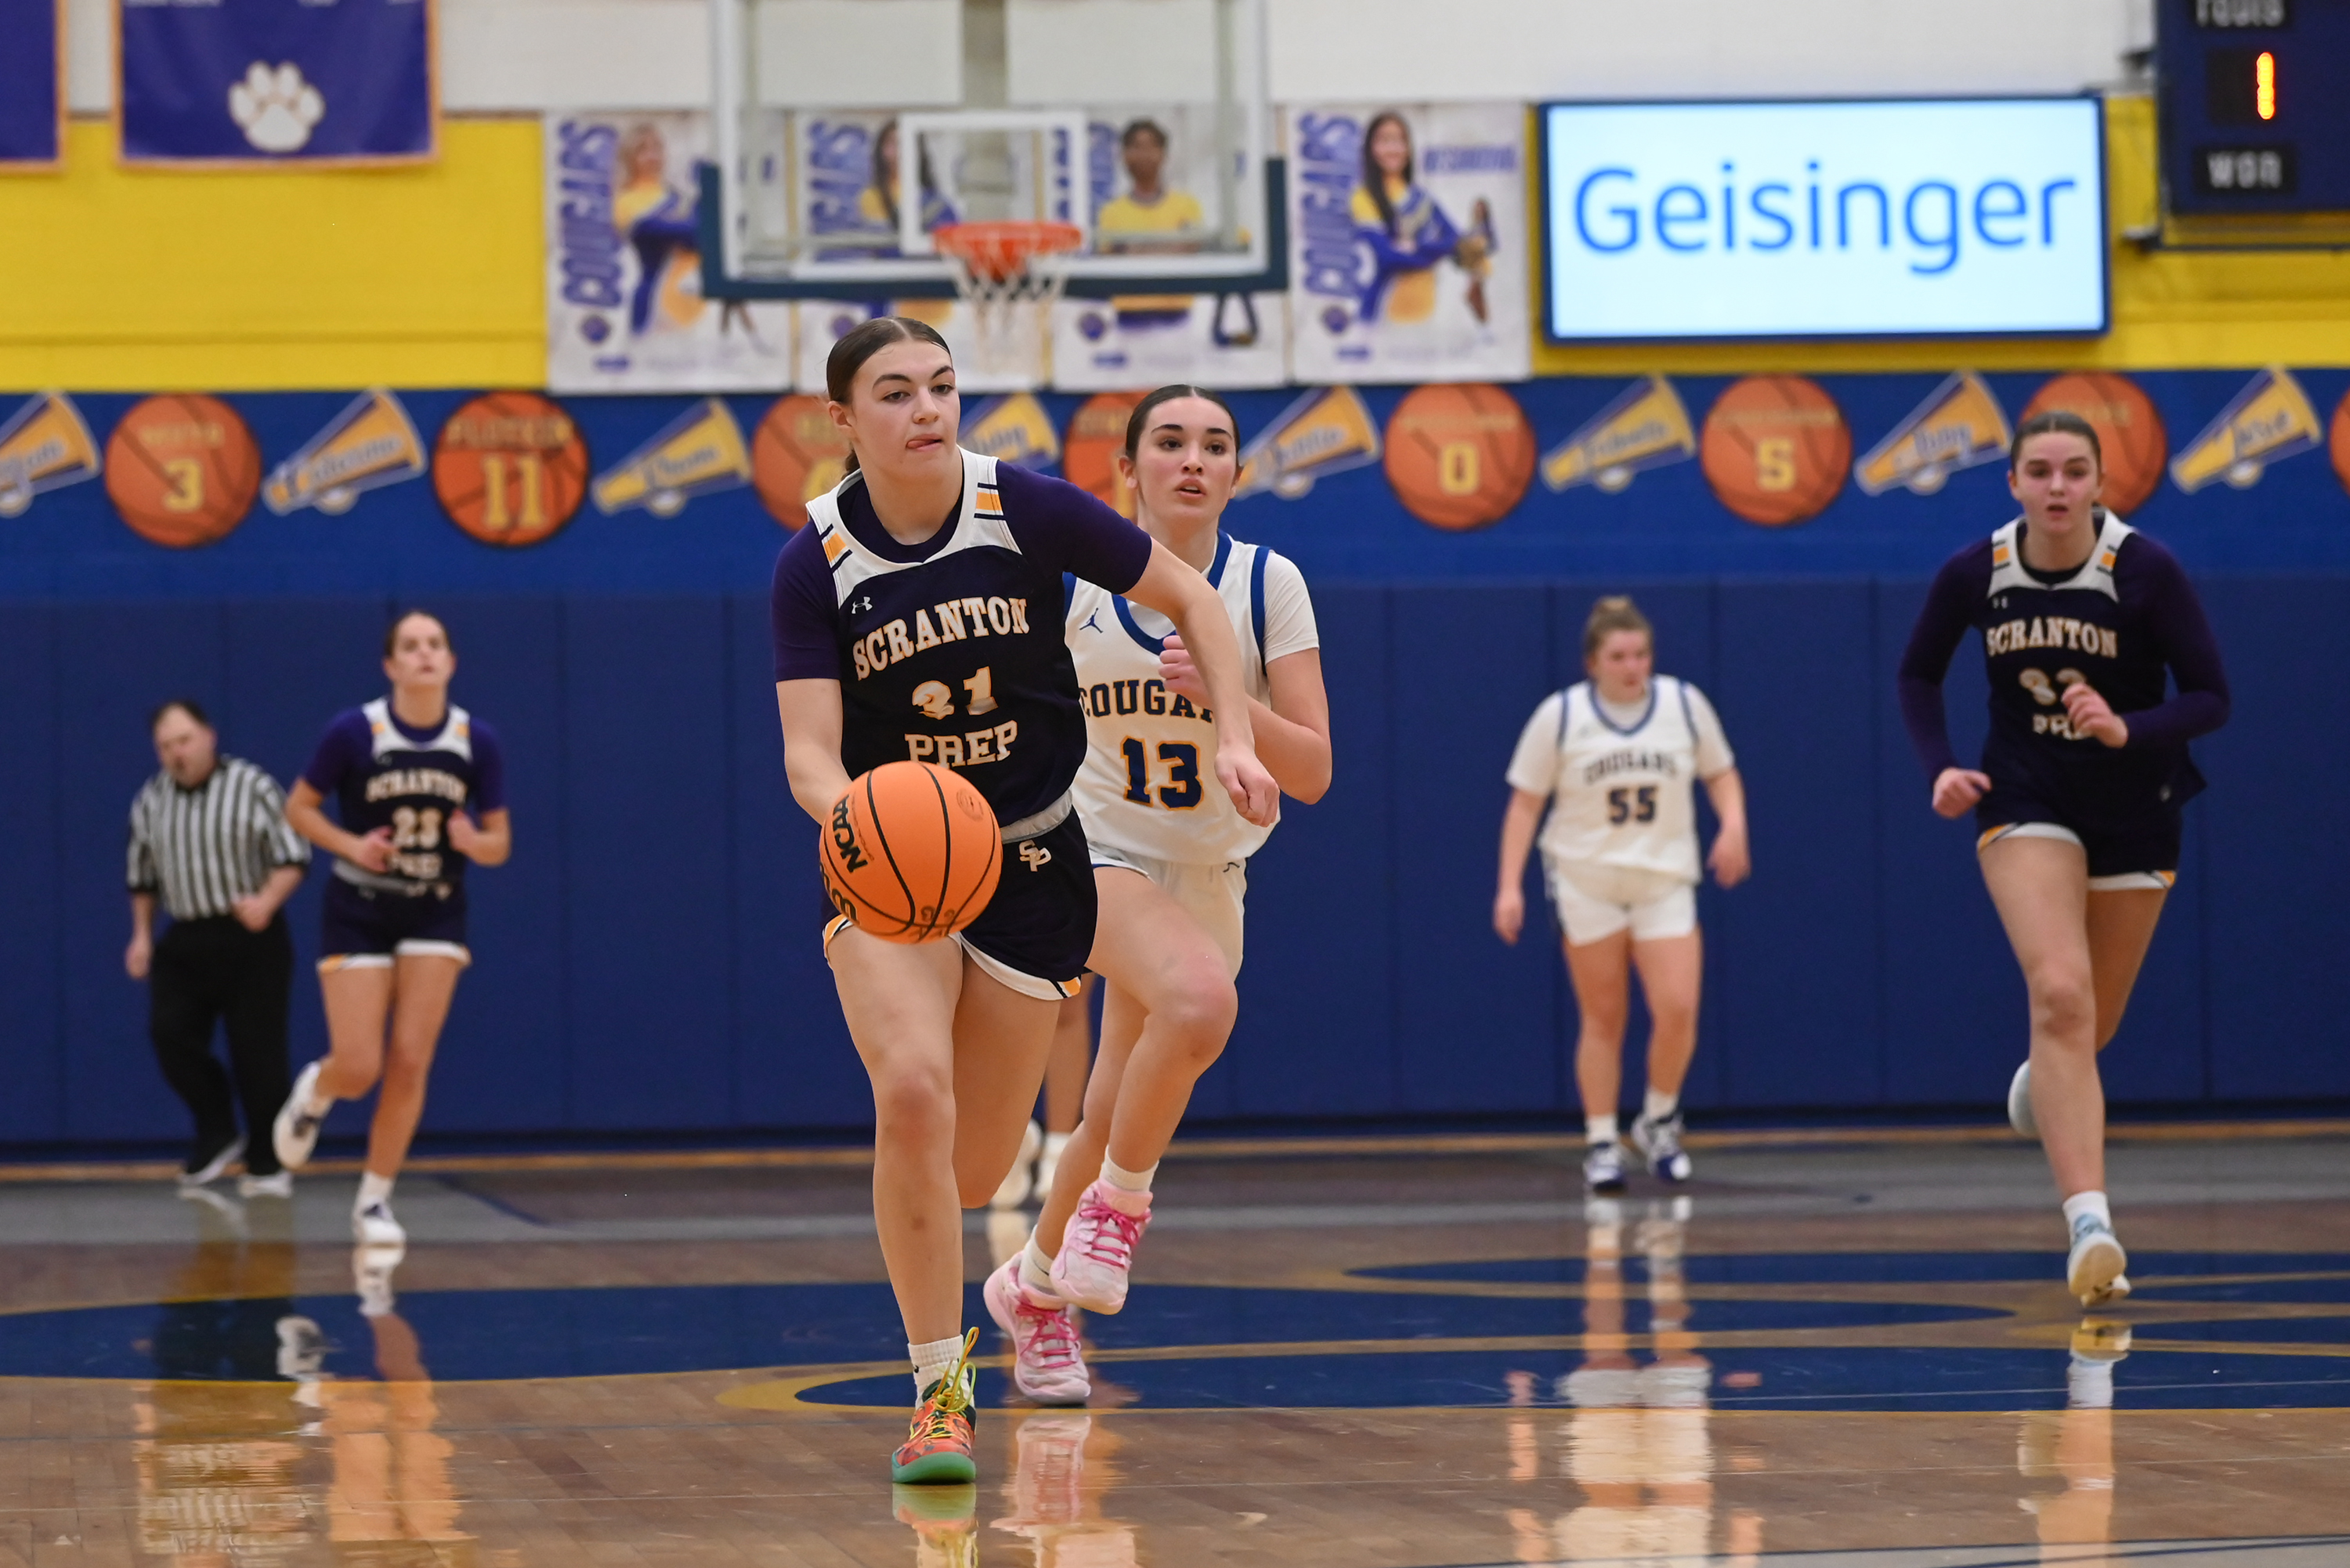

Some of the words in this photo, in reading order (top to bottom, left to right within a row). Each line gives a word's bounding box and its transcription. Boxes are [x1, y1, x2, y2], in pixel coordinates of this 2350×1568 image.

[2255, 51, 2276, 120] 1
[1574, 161, 2077, 275] Geisinger
[161, 457, 204, 513] 3
[483, 454, 546, 529] 11
[1440, 440, 1480, 495] 0
[852, 595, 1030, 681] SCRANTON
[1986, 616, 2119, 658] SCRANTON
[1078, 678, 1213, 724] COUGA
[904, 719, 1018, 770] PREP
[1119, 735, 1205, 811] 13
[832, 793, 868, 873] NCAA
[1606, 784, 1659, 828] 55
